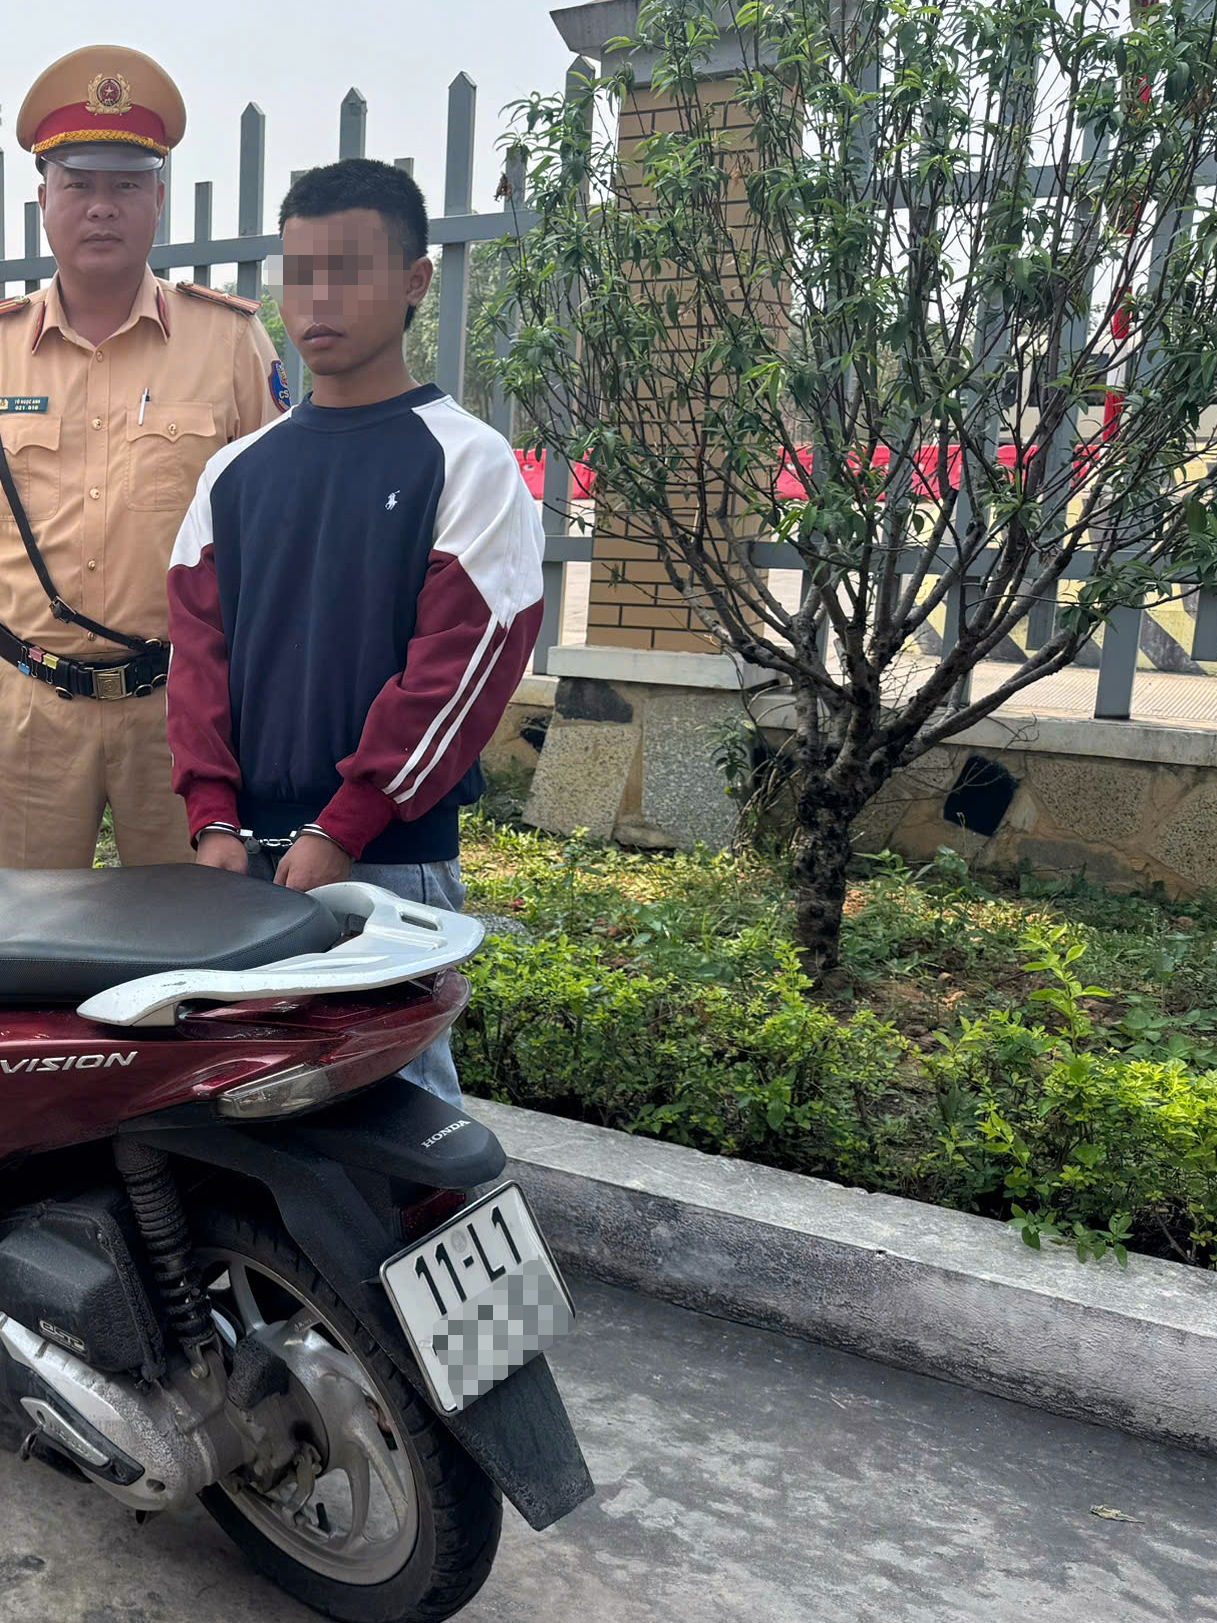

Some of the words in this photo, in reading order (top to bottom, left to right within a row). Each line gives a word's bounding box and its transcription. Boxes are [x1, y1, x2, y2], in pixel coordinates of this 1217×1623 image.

[0, 1051, 139, 1074] VISION
[420, 1119, 471, 1149] HONDA
[413, 1205, 522, 1316] 11-L1
